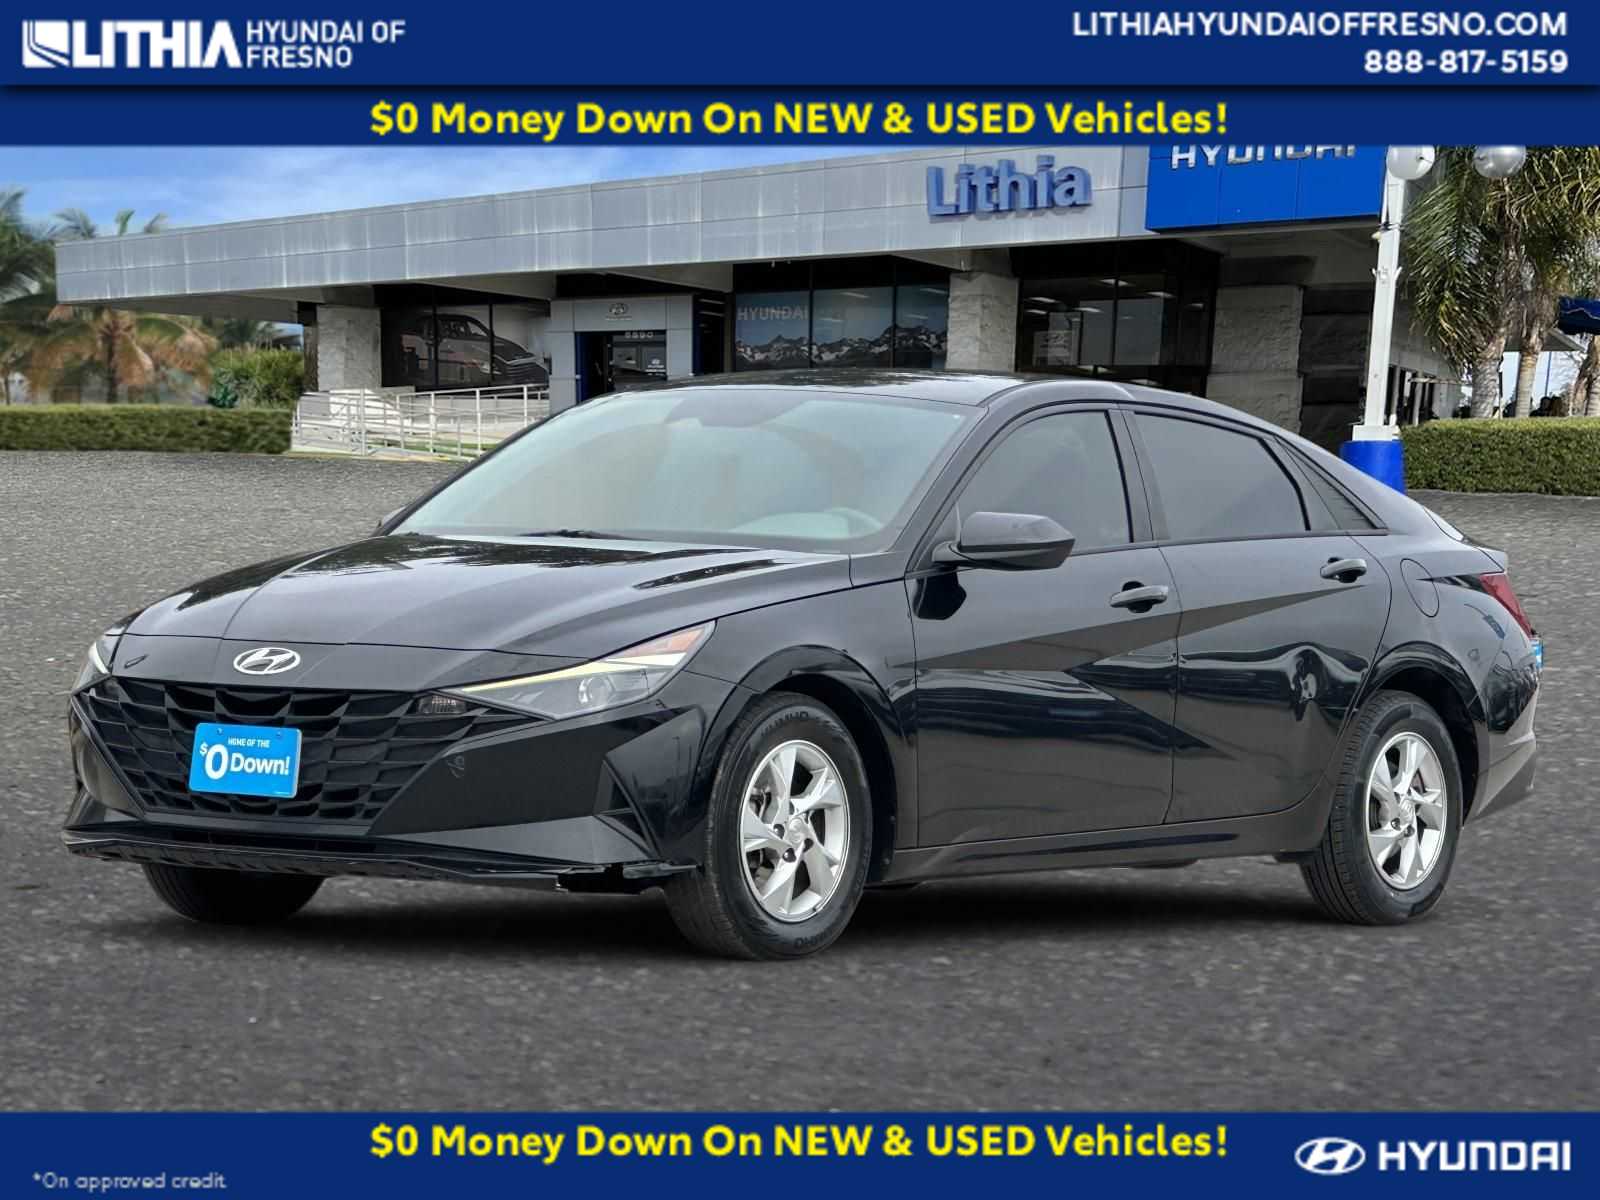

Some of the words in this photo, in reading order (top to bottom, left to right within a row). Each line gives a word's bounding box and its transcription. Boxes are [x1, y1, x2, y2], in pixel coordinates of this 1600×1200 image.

[927, 154, 1092, 217] Lithia
[736, 305, 808, 320] HYUNDAI
[228, 738, 246, 747] HOME
[246, 738, 257, 747] OF
[257, 740, 270, 748] THE
[230, 752, 291, 776] Down!
